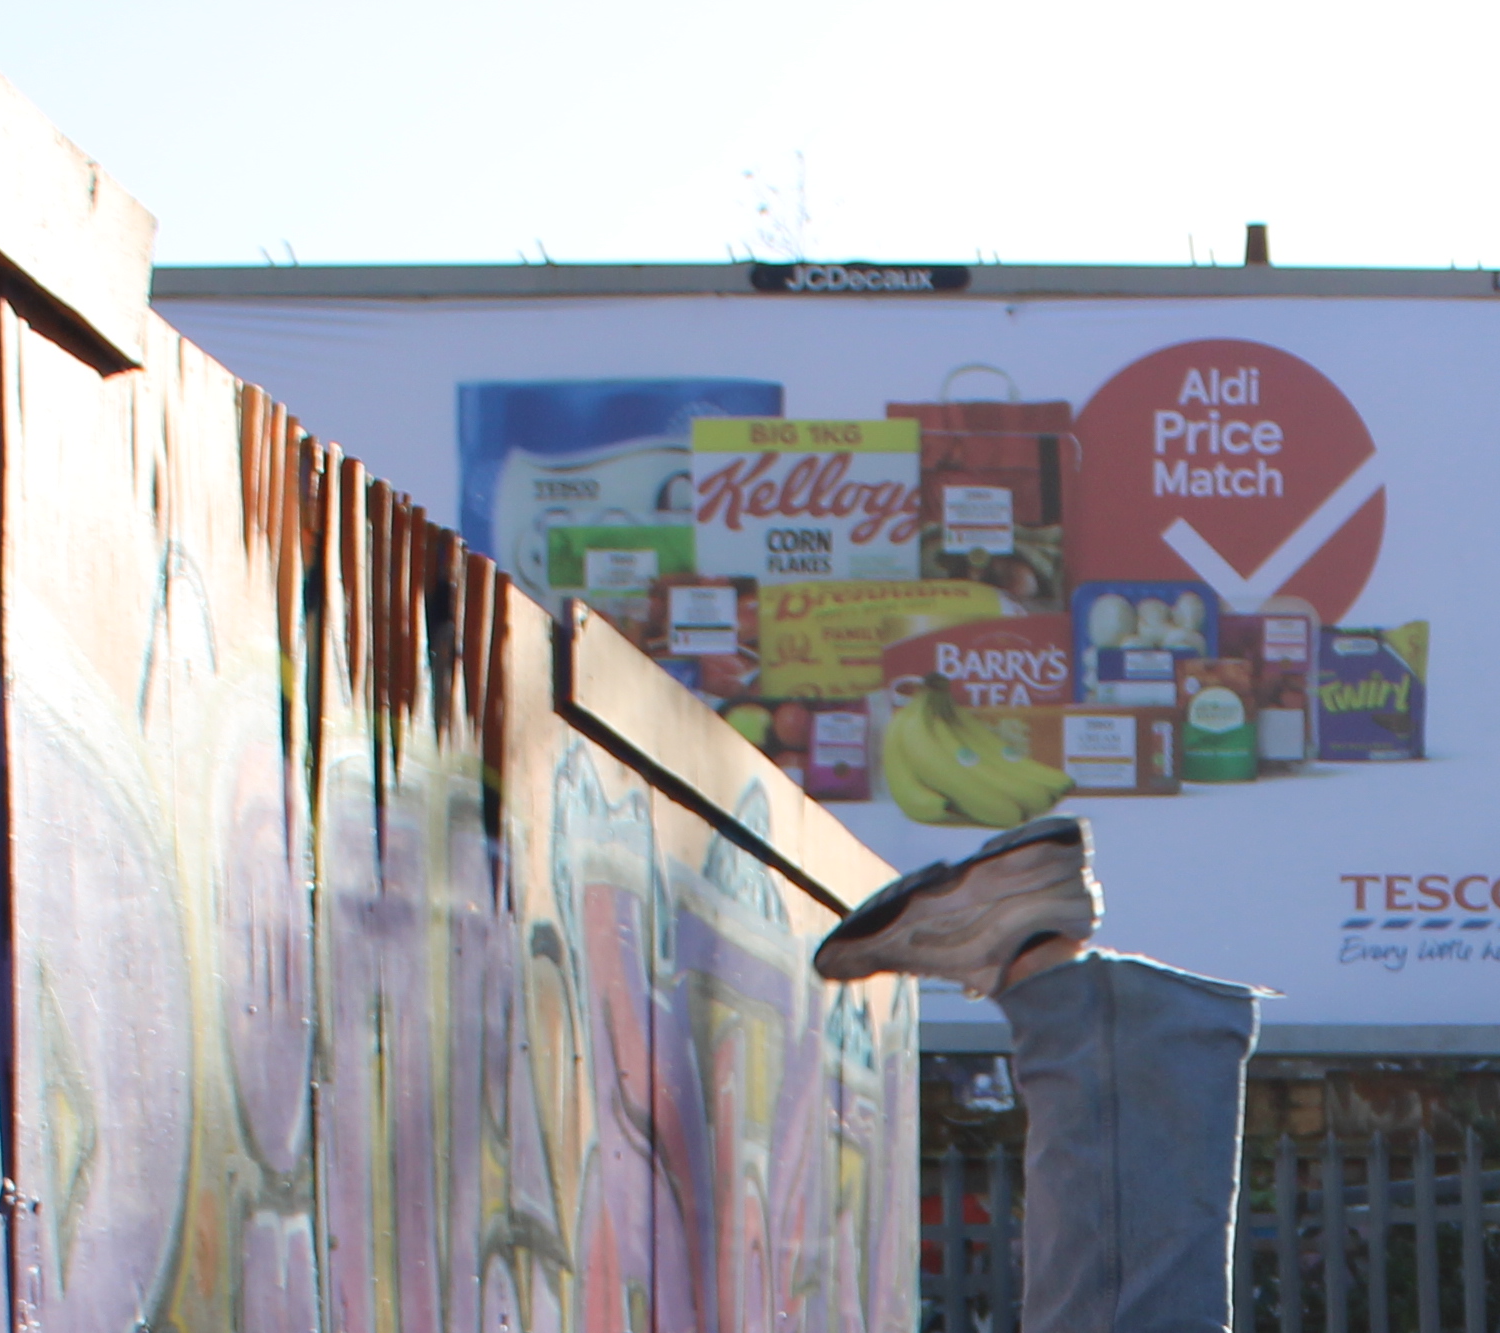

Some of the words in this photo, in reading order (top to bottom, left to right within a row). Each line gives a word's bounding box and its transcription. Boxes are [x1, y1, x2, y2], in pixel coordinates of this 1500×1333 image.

[785, 264, 934, 292] JCDecaux
[1178, 367, 1261, 406] Aldi
[750, 422, 799, 445] BIG
[809, 422, 862, 444] 1KG
[1153, 410, 1284, 455] Price
[1153, 460, 1284, 497] Match
[766, 528, 833, 554] CORN
[766, 555, 833, 575] FLAKES
[935, 641, 1069, 689] BARRY'S
[964, 683, 1032, 706] TEA
[1318, 670, 1412, 714] Twirl
[1338, 934, 1408, 973] Every
[1417, 938, 1474, 962] little
